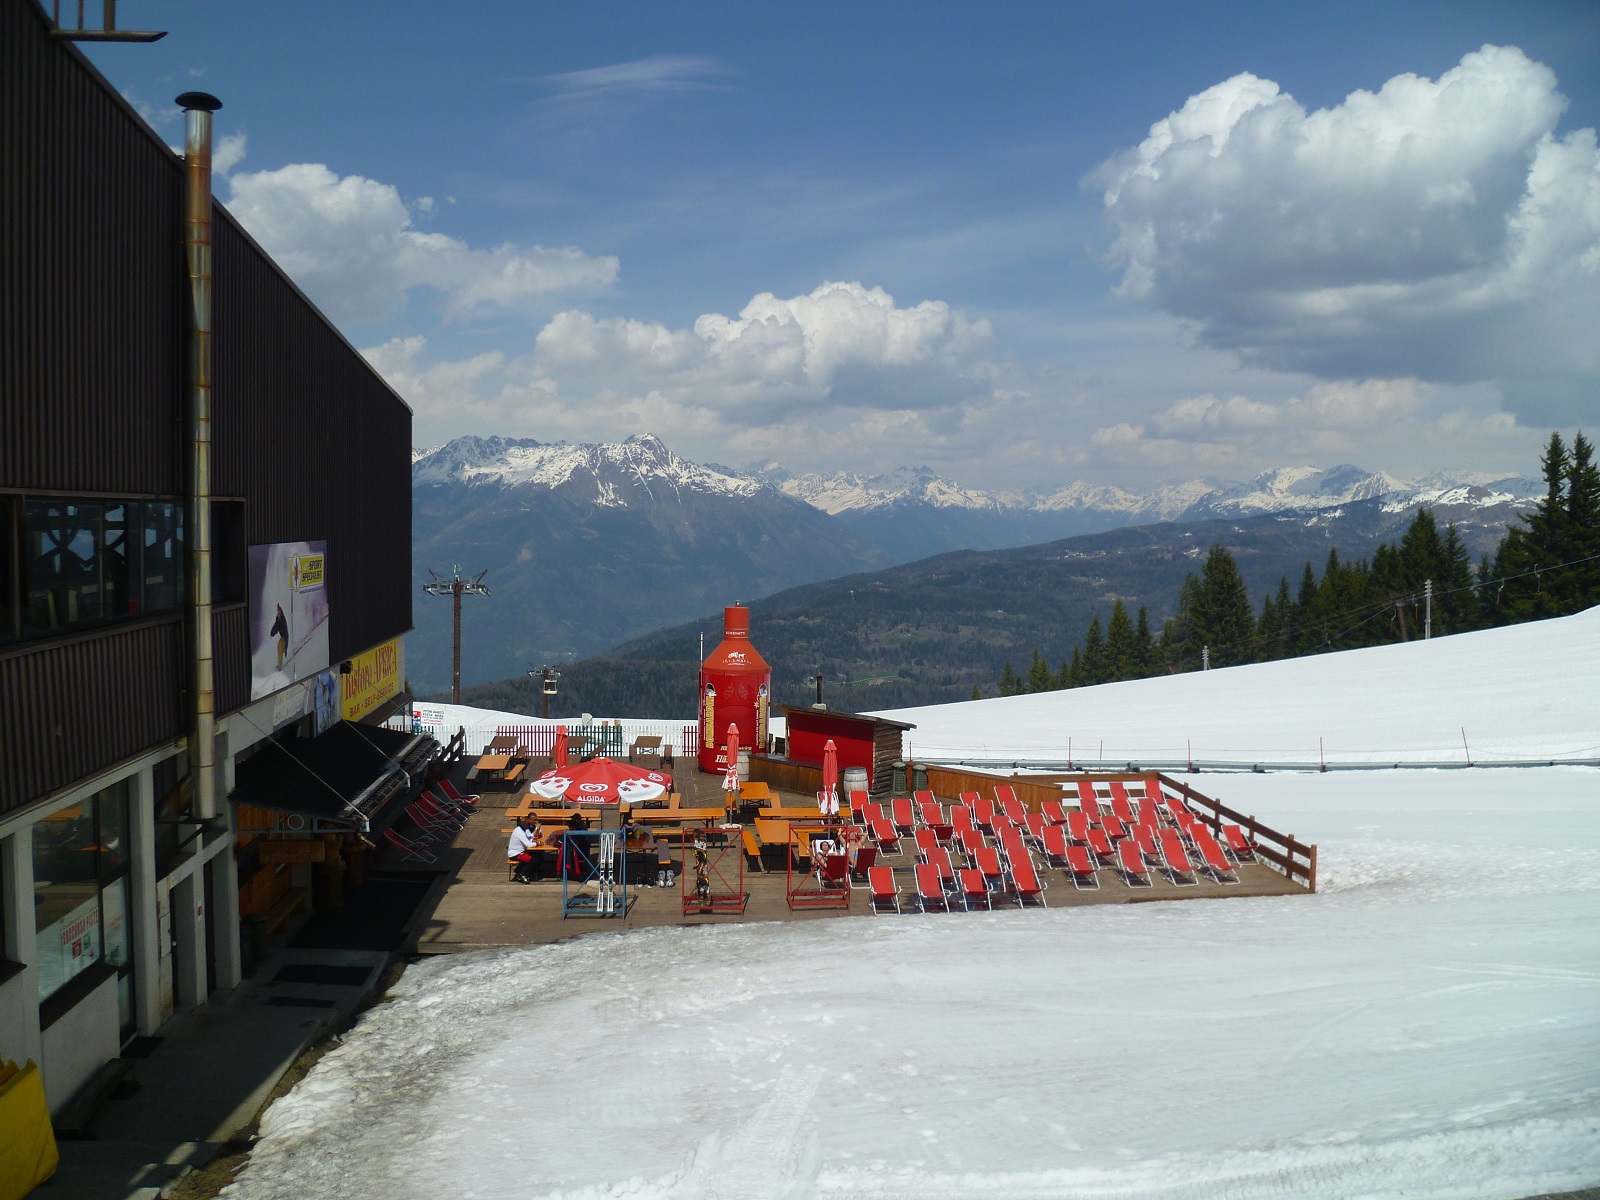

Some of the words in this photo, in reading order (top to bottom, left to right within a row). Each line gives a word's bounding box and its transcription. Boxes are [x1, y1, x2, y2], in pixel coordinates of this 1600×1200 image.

[309, 559, 322, 571] SPORT
[302, 570, 322, 582] SPECIALIST
[349, 702, 361, 718] BAR
[364, 682, 395, 709] SELF-SERVICE
[577, 795, 605, 803] ALGIDA
